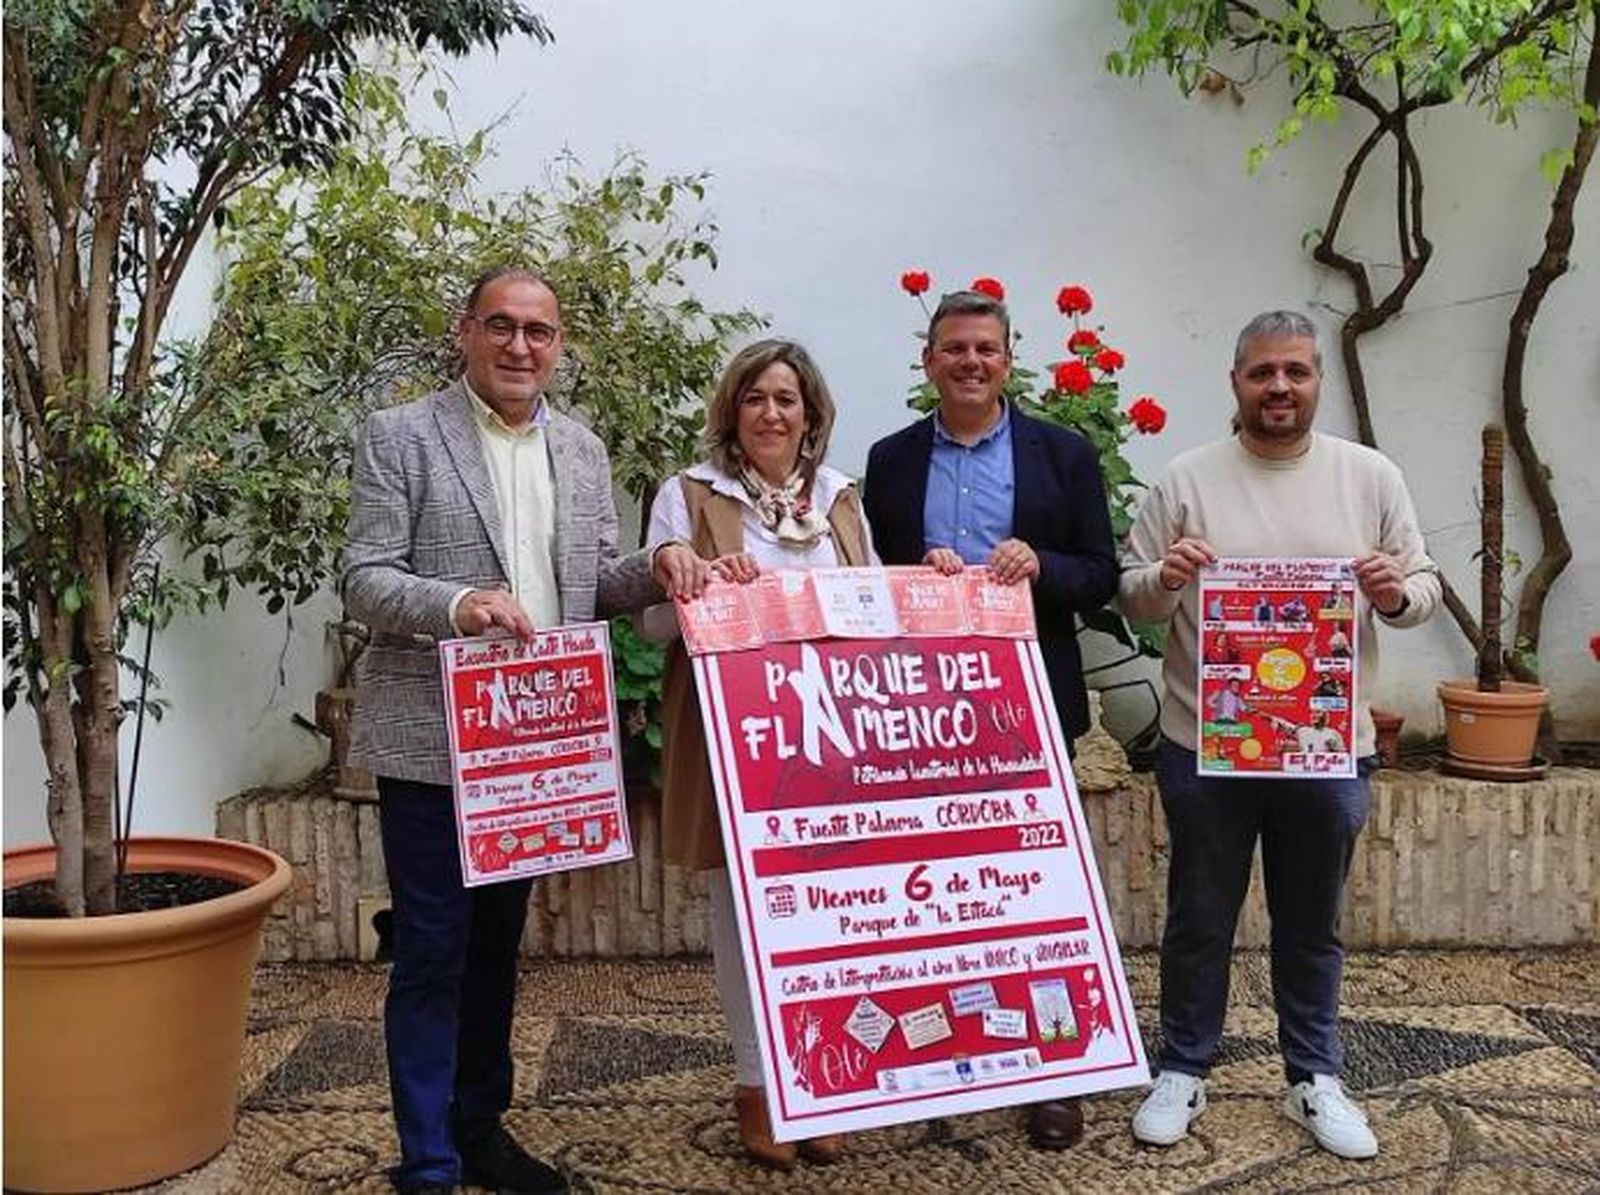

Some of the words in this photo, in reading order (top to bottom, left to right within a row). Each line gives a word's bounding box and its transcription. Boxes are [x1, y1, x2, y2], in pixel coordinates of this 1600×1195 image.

[476, 669, 556, 699] PARQUE
[562, 667, 593, 688] DEL
[765, 642, 928, 706] PARQUE
[938, 651, 1001, 691] DEL
[462, 691, 577, 730] FLAMENCO
[741, 698, 977, 766] FLAMENCO
[794, 813, 849, 841] Fuente
[856, 810, 923, 836] Palmera
[1018, 823, 1062, 849] 2022
[807, 885, 887, 911] Viernes
[904, 864, 933, 902] 6
[945, 873, 969, 895] de
[978, 867, 1041, 896] Mayo
[840, 914, 898, 938] Parque
[904, 907, 920, 928] de
